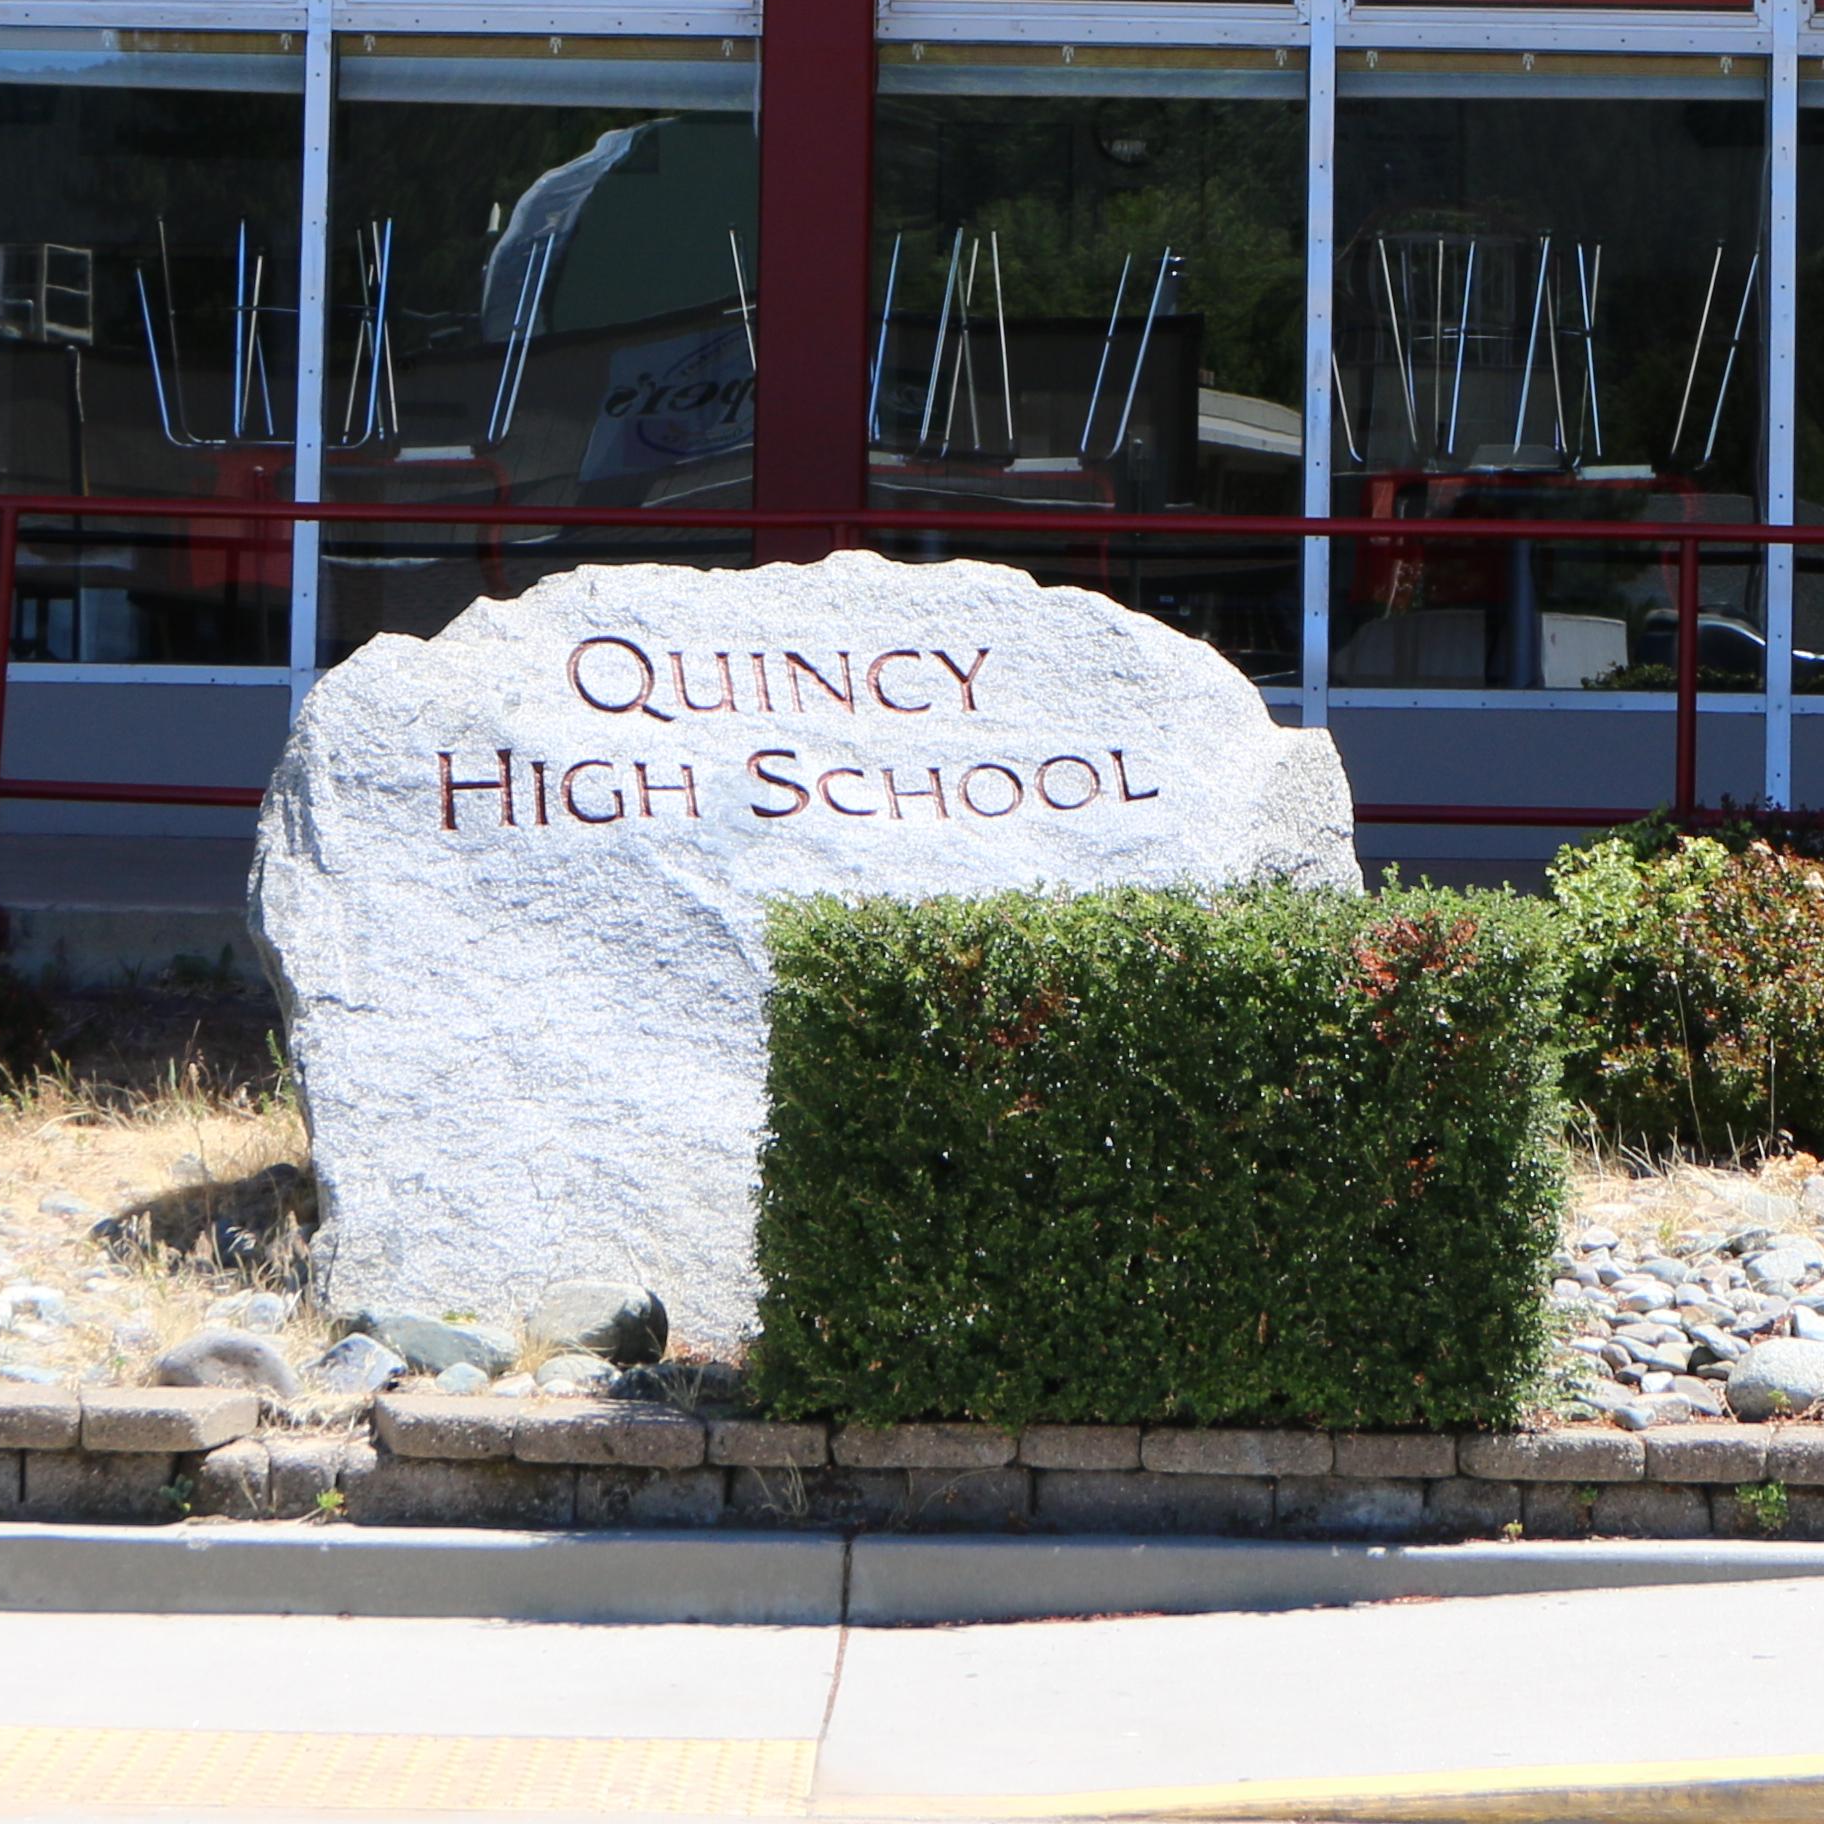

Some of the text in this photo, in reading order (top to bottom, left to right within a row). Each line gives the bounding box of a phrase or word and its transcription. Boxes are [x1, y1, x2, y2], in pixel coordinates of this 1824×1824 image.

[565, 635, 991, 723] QUINCY
[437, 747, 1160, 831] HIGH SCHOOL
